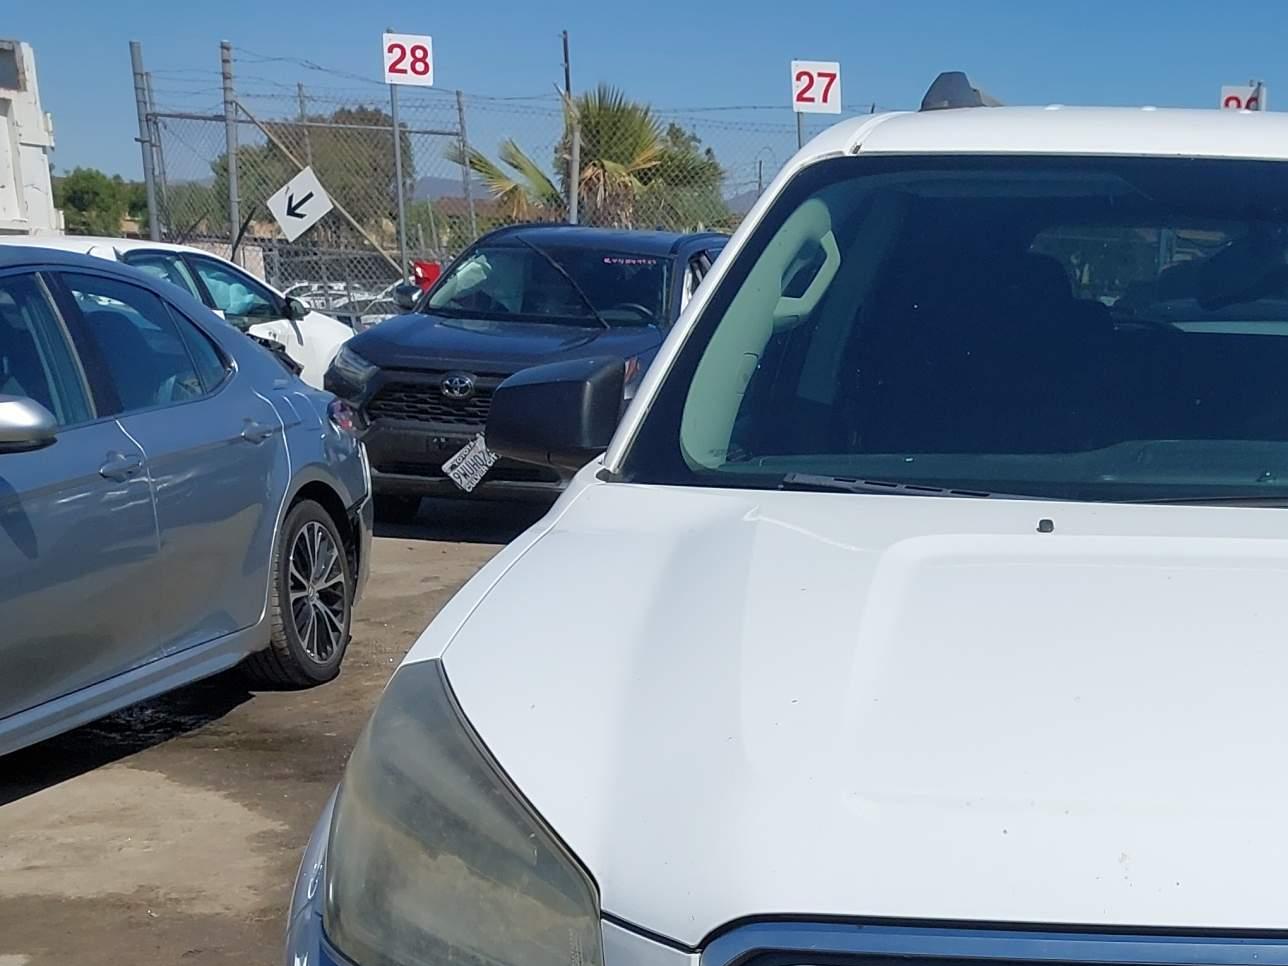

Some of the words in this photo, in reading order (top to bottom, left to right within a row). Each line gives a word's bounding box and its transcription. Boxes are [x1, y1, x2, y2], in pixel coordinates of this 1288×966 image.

[387, 43, 430, 76] 28
[795, 71, 837, 103] 27
[452, 450, 488, 484] 9WUH07
